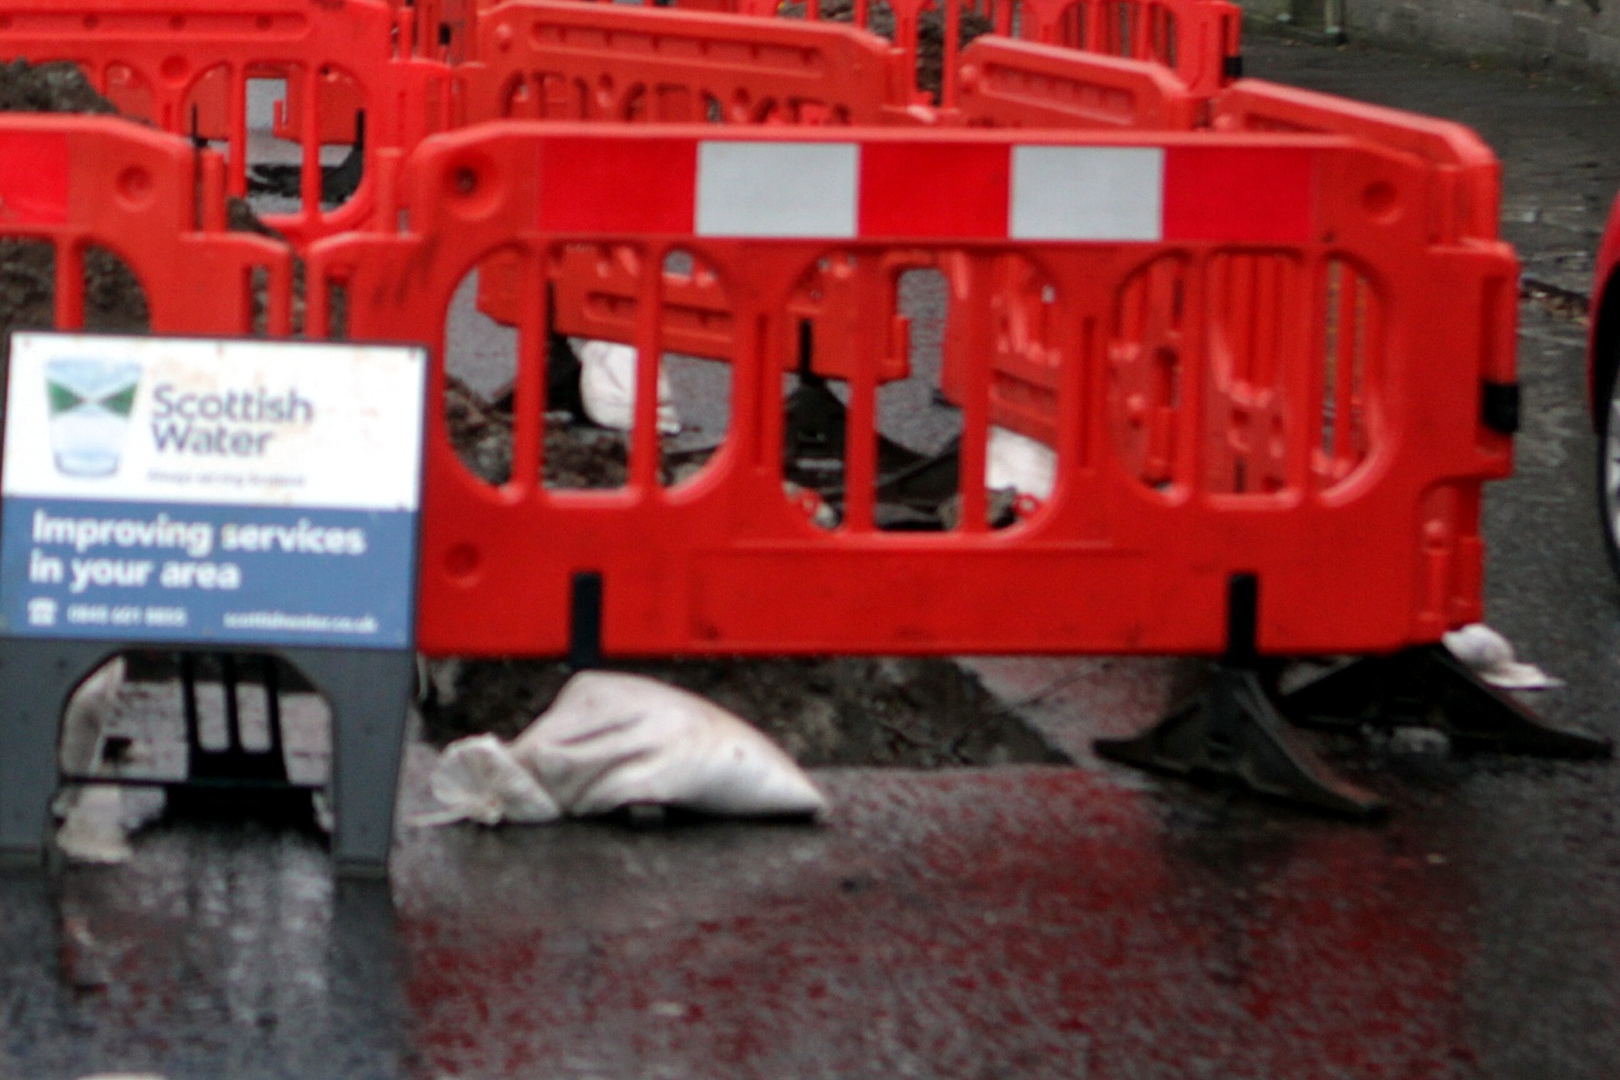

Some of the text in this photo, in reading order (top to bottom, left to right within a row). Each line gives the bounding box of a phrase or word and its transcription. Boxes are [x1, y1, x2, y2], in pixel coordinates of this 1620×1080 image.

[152, 383, 314, 427] Scottish
[153, 422, 274, 457] Water
[33, 509, 368, 557] Improving services
[30, 548, 242, 594] in your area
